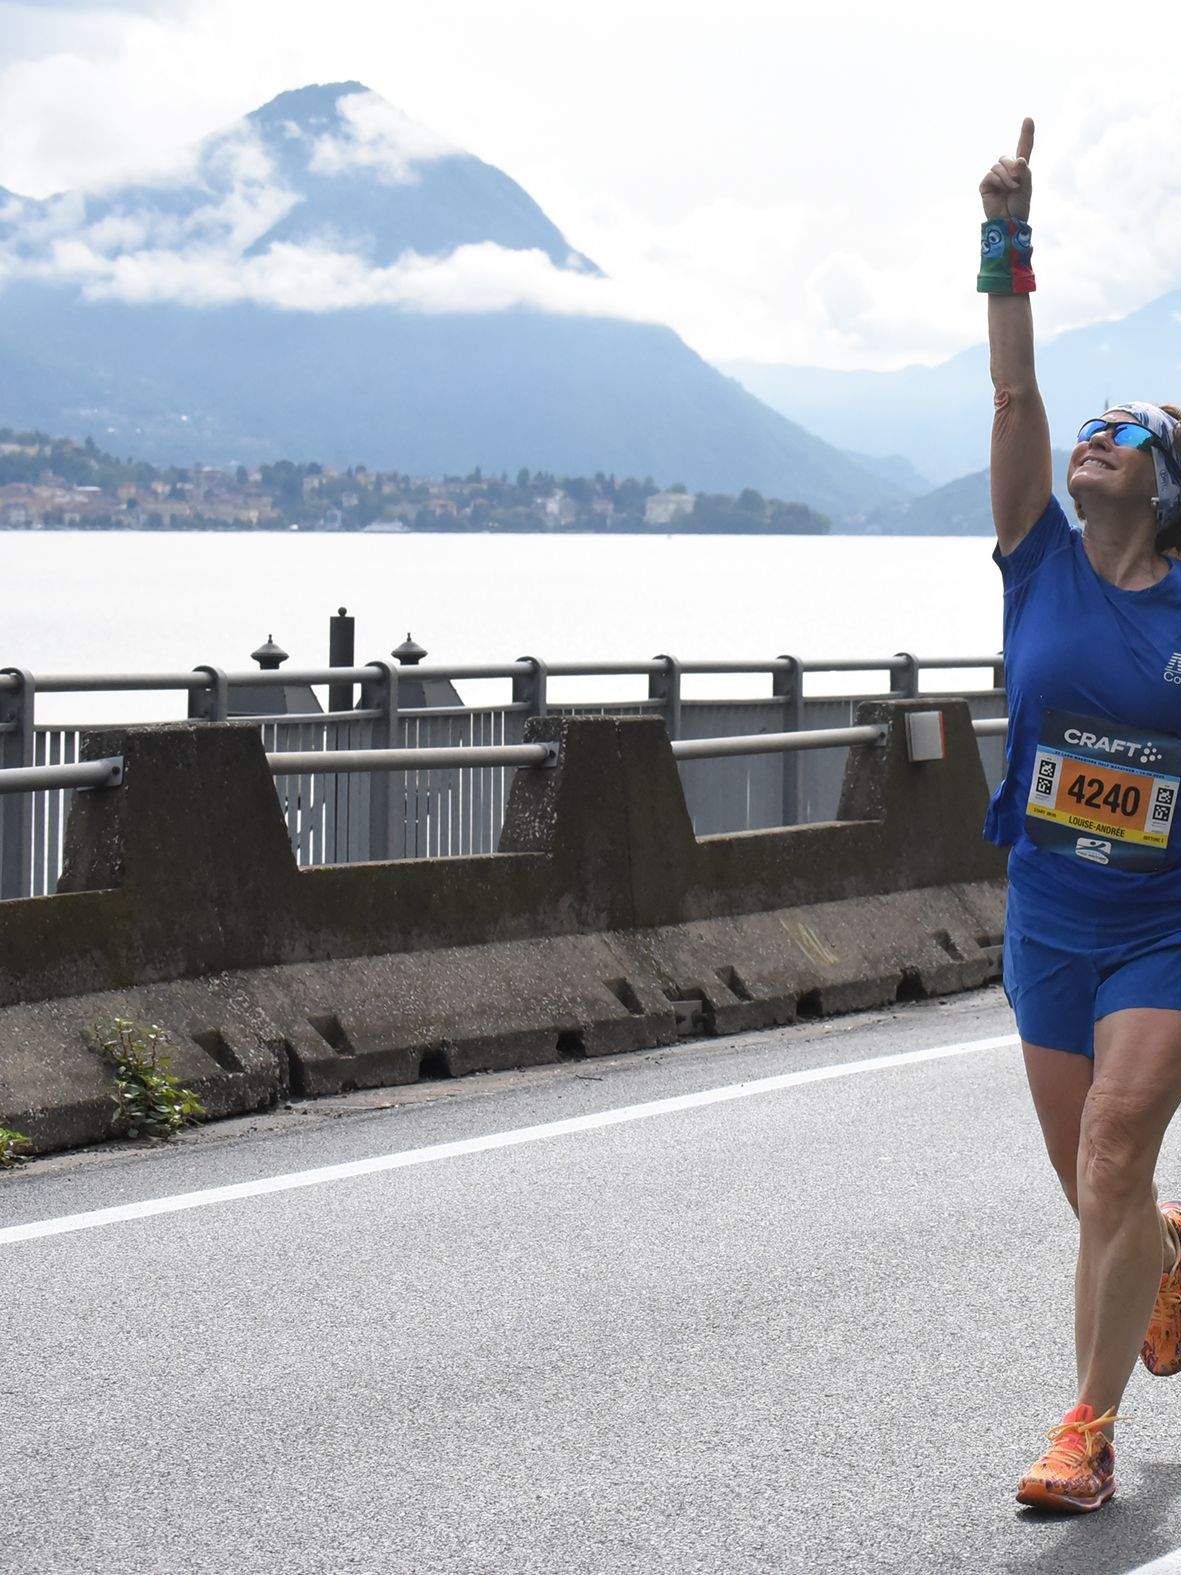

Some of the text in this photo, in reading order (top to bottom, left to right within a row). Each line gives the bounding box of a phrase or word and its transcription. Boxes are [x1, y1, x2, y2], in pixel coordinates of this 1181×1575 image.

[1064, 728, 1142, 758] CRAFT
[1067, 774, 1141, 817] 4240
[1069, 816, 1126, 838] LOUISE-ANDRÉE
